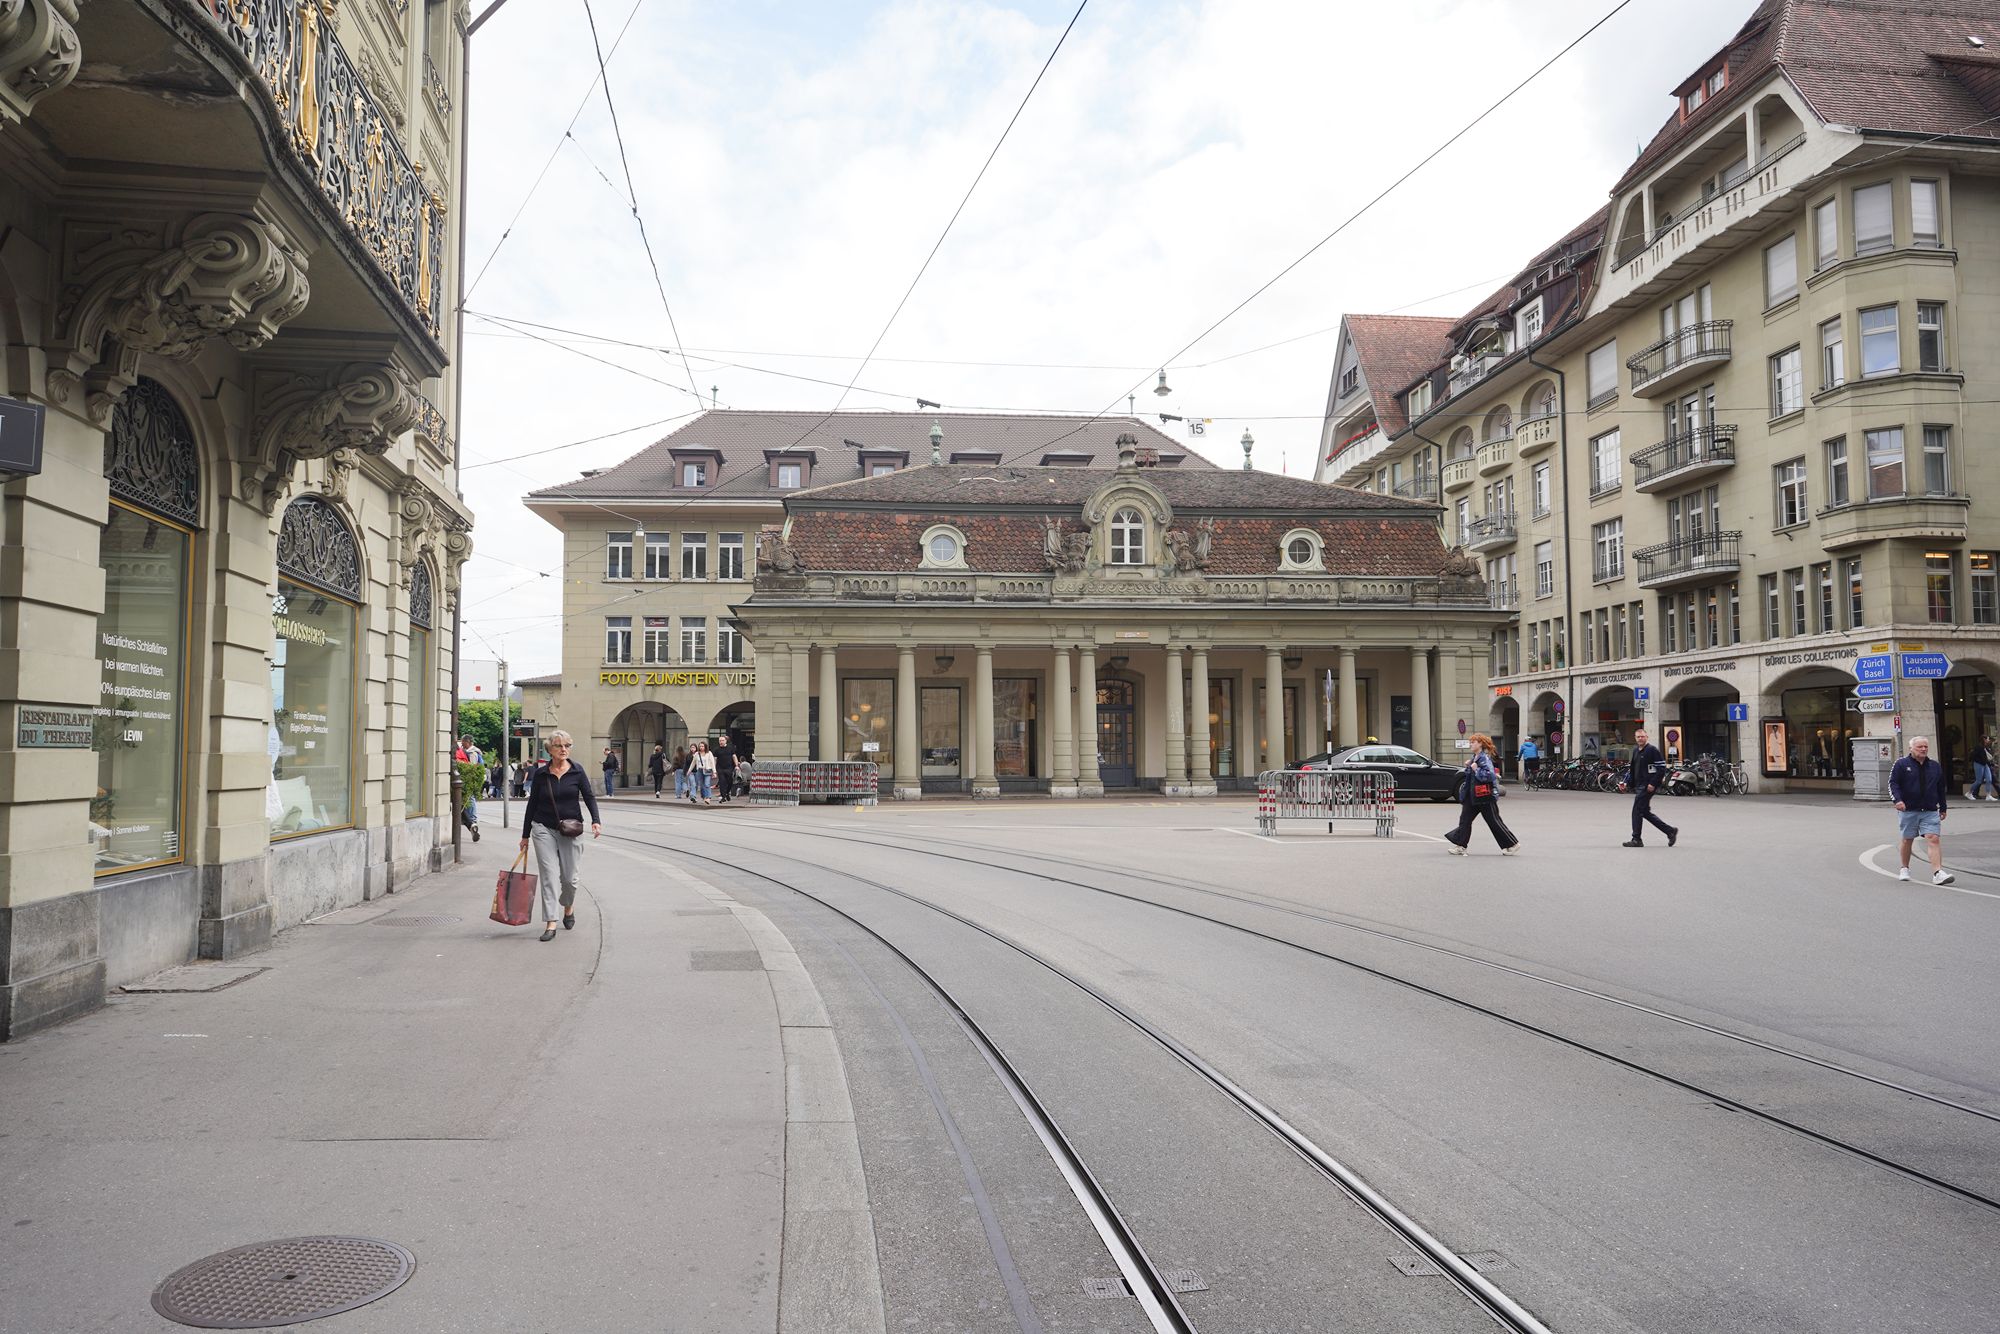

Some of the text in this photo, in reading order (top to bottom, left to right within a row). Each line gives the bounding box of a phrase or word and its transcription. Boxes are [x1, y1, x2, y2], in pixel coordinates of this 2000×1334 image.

[1190, 423, 1204, 434] 15
[1765, 655, 1786, 667] BÜRKI
[1788, 655, 1802, 664] LES
[1803, 648, 1858, 662] COLLECTIONS
[1905, 656, 1943, 665] Lausanne
[105, 657, 116, 670] bei
[1682, 665, 1693, 675] LES
[1694, 661, 1736, 674] COLLECTIONS
[1862, 658, 1886, 669] Zürich
[1608, 672, 1642, 683] COLLECTIONS
[1864, 669, 1884, 678] Basel
[1908, 667, 1942, 677] Fribourg
[600, 672, 639, 686] FOTO
[645, 672, 720, 686] ZUMSTEIN
[153, 689, 171, 700] Leinen
[1638, 689, 1646, 698] P
[1860, 685, 1891, 694] Interlaken
[1862, 702, 1883, 710] Casino
[21, 710, 92, 727] RESTAURANT
[21, 729, 92, 745] DU THEATRE
[124, 730, 143, 742] LEVIN
